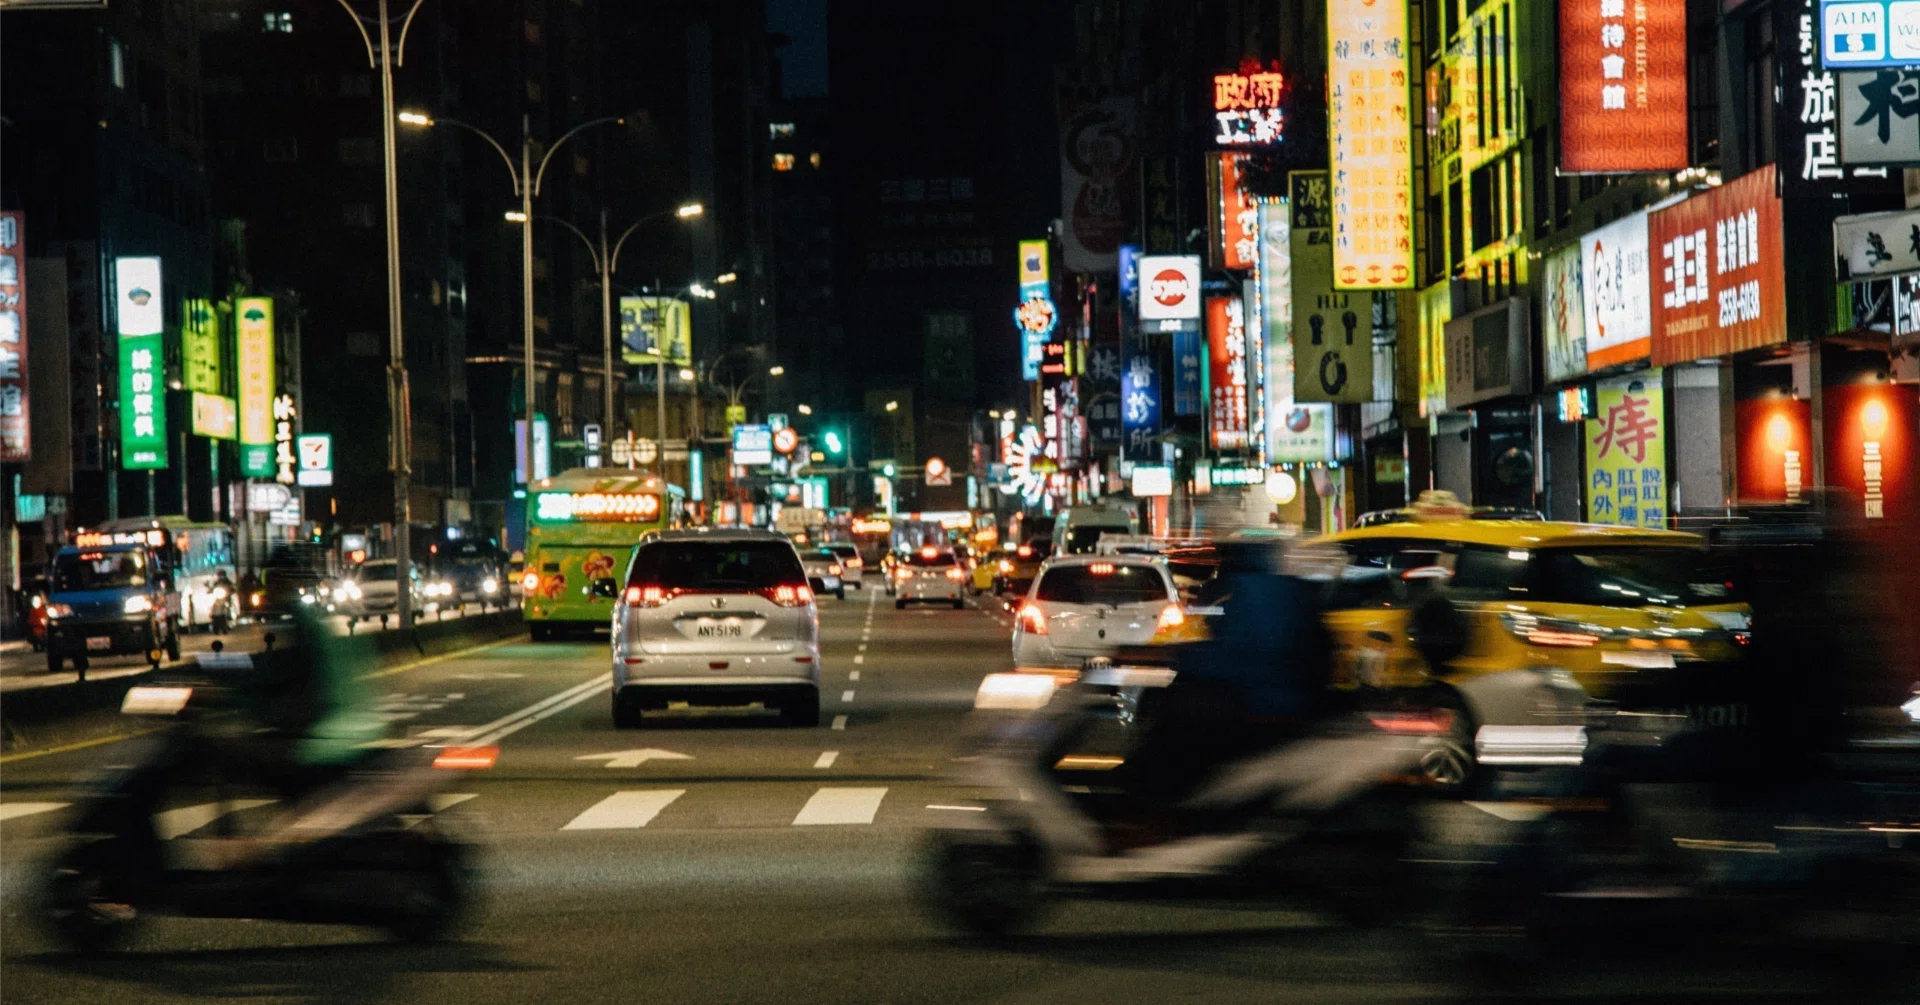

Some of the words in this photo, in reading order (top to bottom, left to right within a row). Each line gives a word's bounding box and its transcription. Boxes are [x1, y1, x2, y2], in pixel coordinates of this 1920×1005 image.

[1834, 11, 1876, 25] ATM
[1214, 72, 1283, 109] 政府
[1719, 279, 1761, 328] 2558-6038
[1593, 394, 1658, 463] 痔
[1593, 468, 1614, 525] 內外
